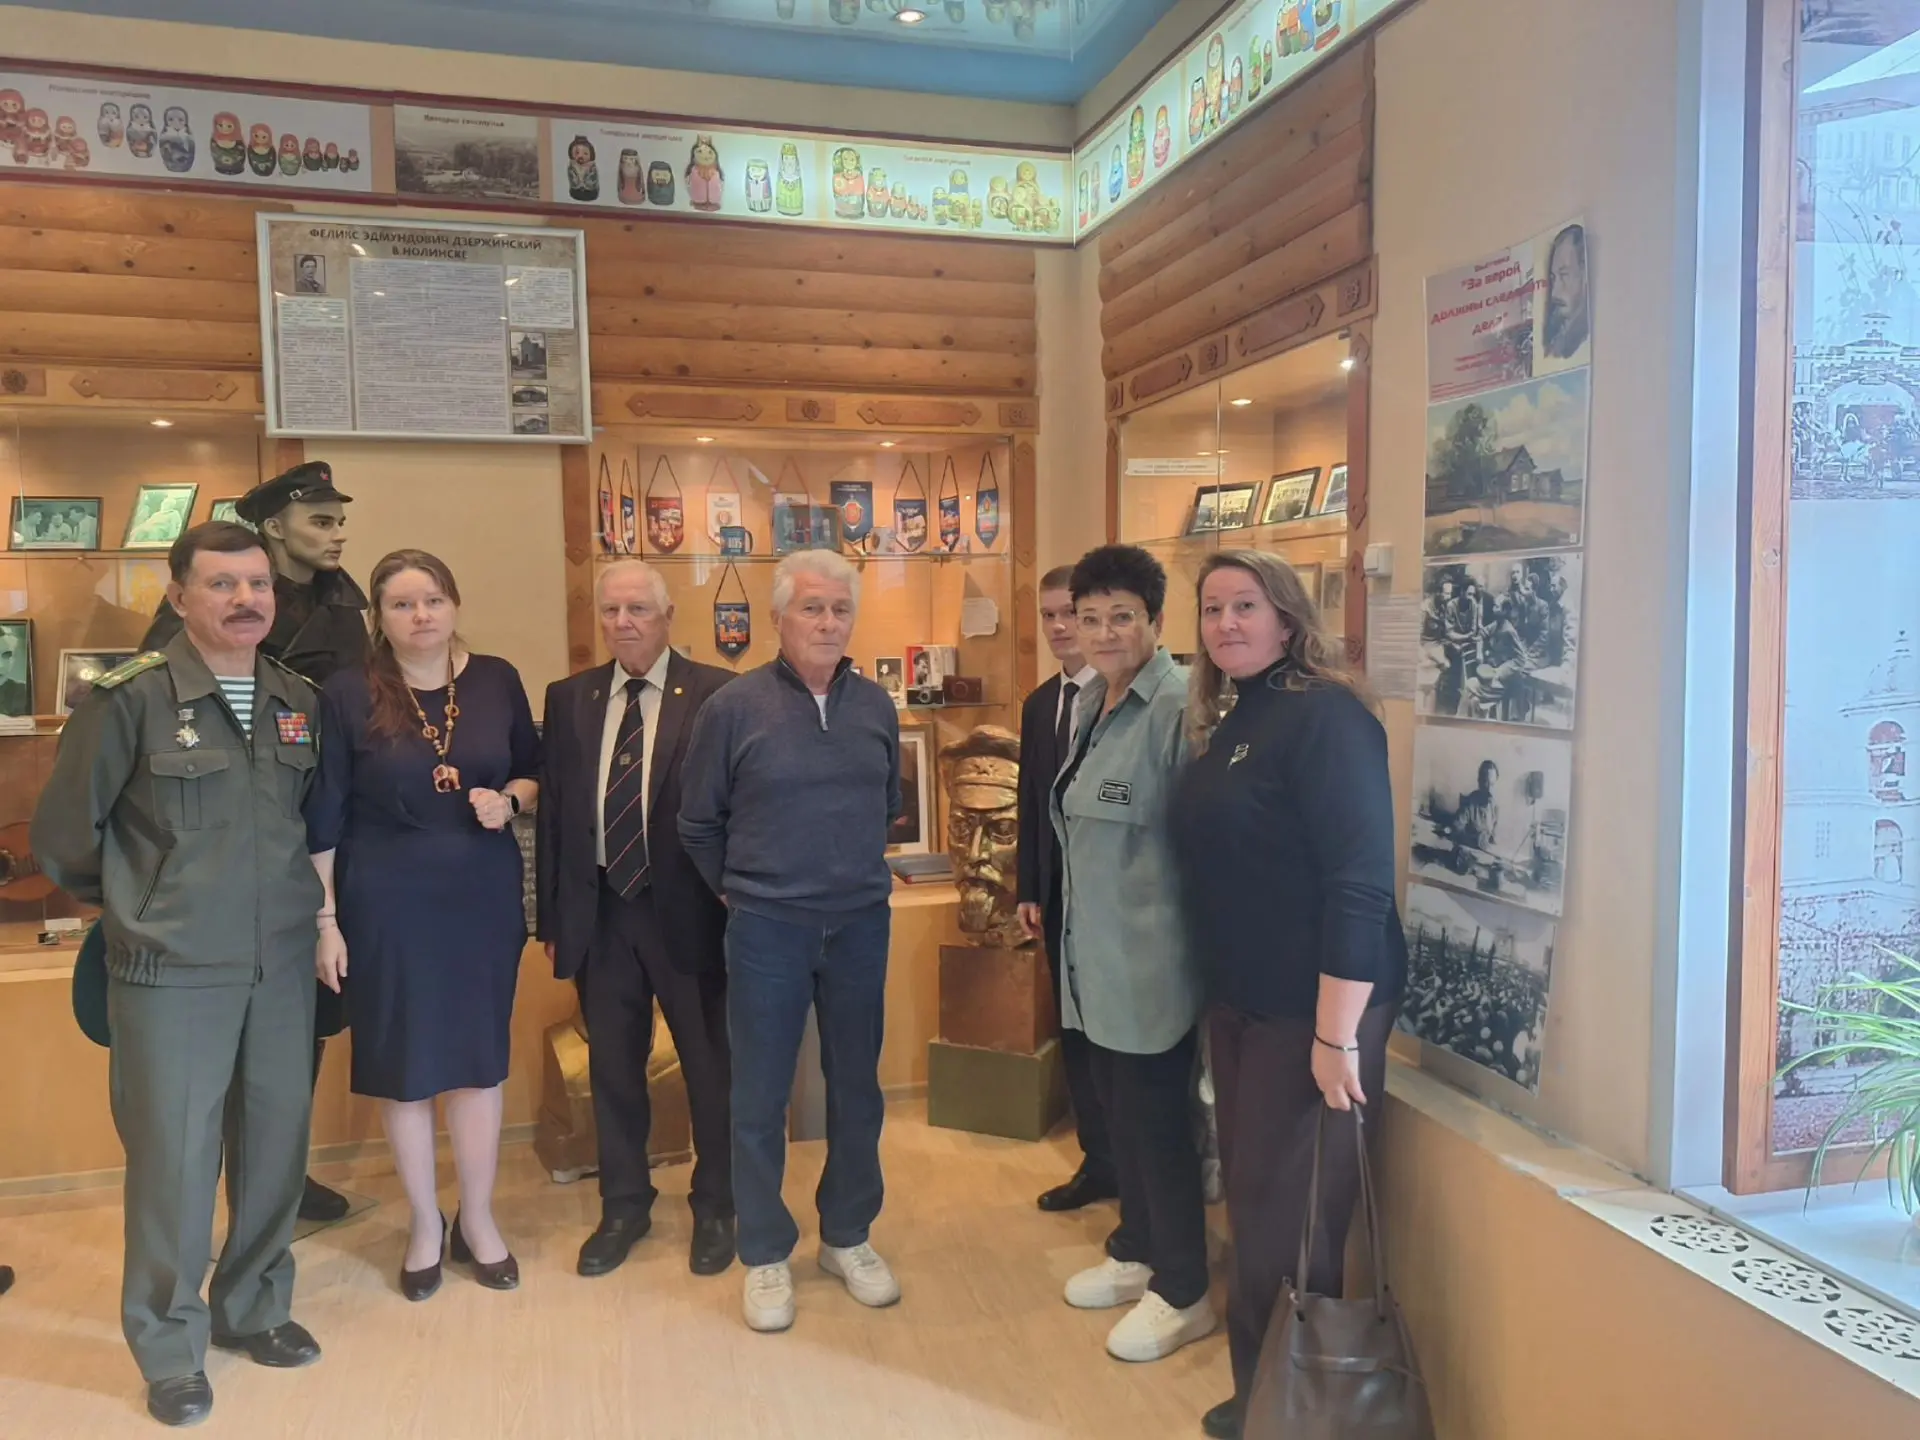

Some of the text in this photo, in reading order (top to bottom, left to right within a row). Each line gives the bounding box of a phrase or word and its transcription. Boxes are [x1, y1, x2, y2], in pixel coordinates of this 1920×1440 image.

[310, 228, 542, 250] ФЕЛИКС ЭДМУНДОВИЧ ДЗЕРЖИНСКИЙ
[392, 246, 469, 260] В НОЛИНСКЕ
